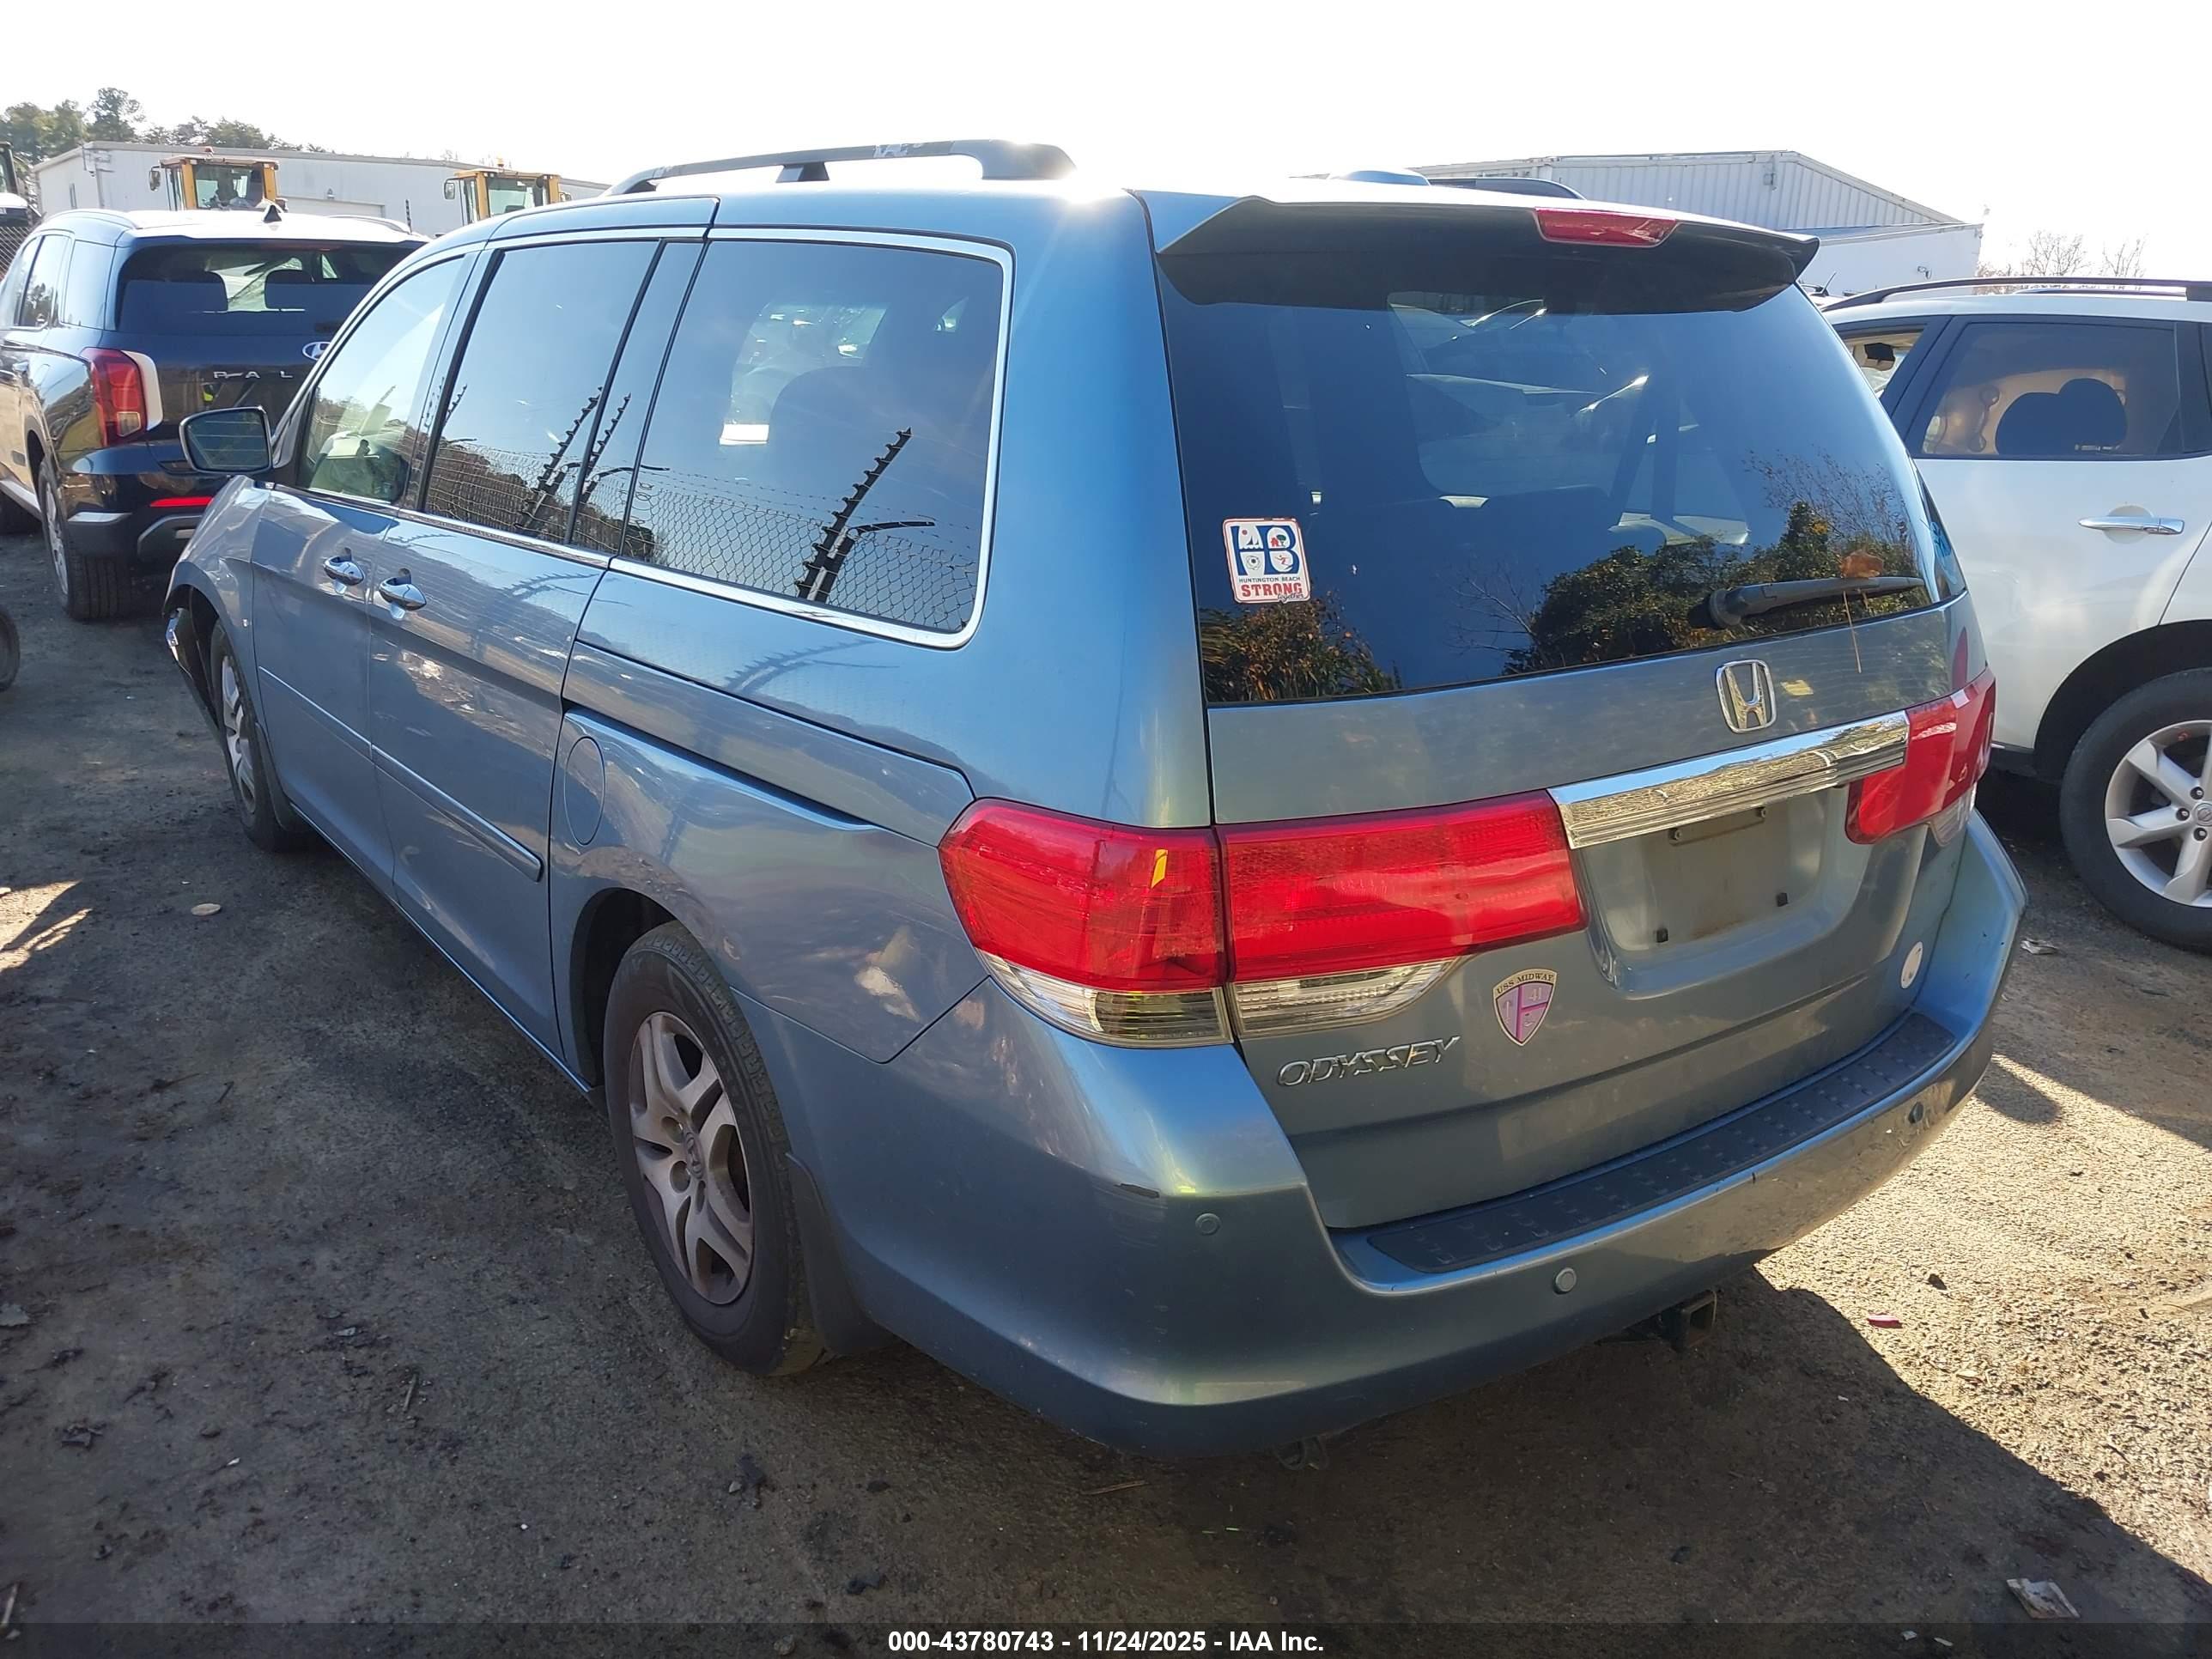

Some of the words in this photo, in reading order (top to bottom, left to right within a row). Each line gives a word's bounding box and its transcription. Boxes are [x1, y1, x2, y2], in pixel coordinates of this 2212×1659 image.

[1241, 582, 1303, 597] STRONG
[1496, 979, 1515, 995] USS
[1516, 972, 1554, 983] MIDWAY
[1278, 1036, 1461, 1086] ODYSSEY
